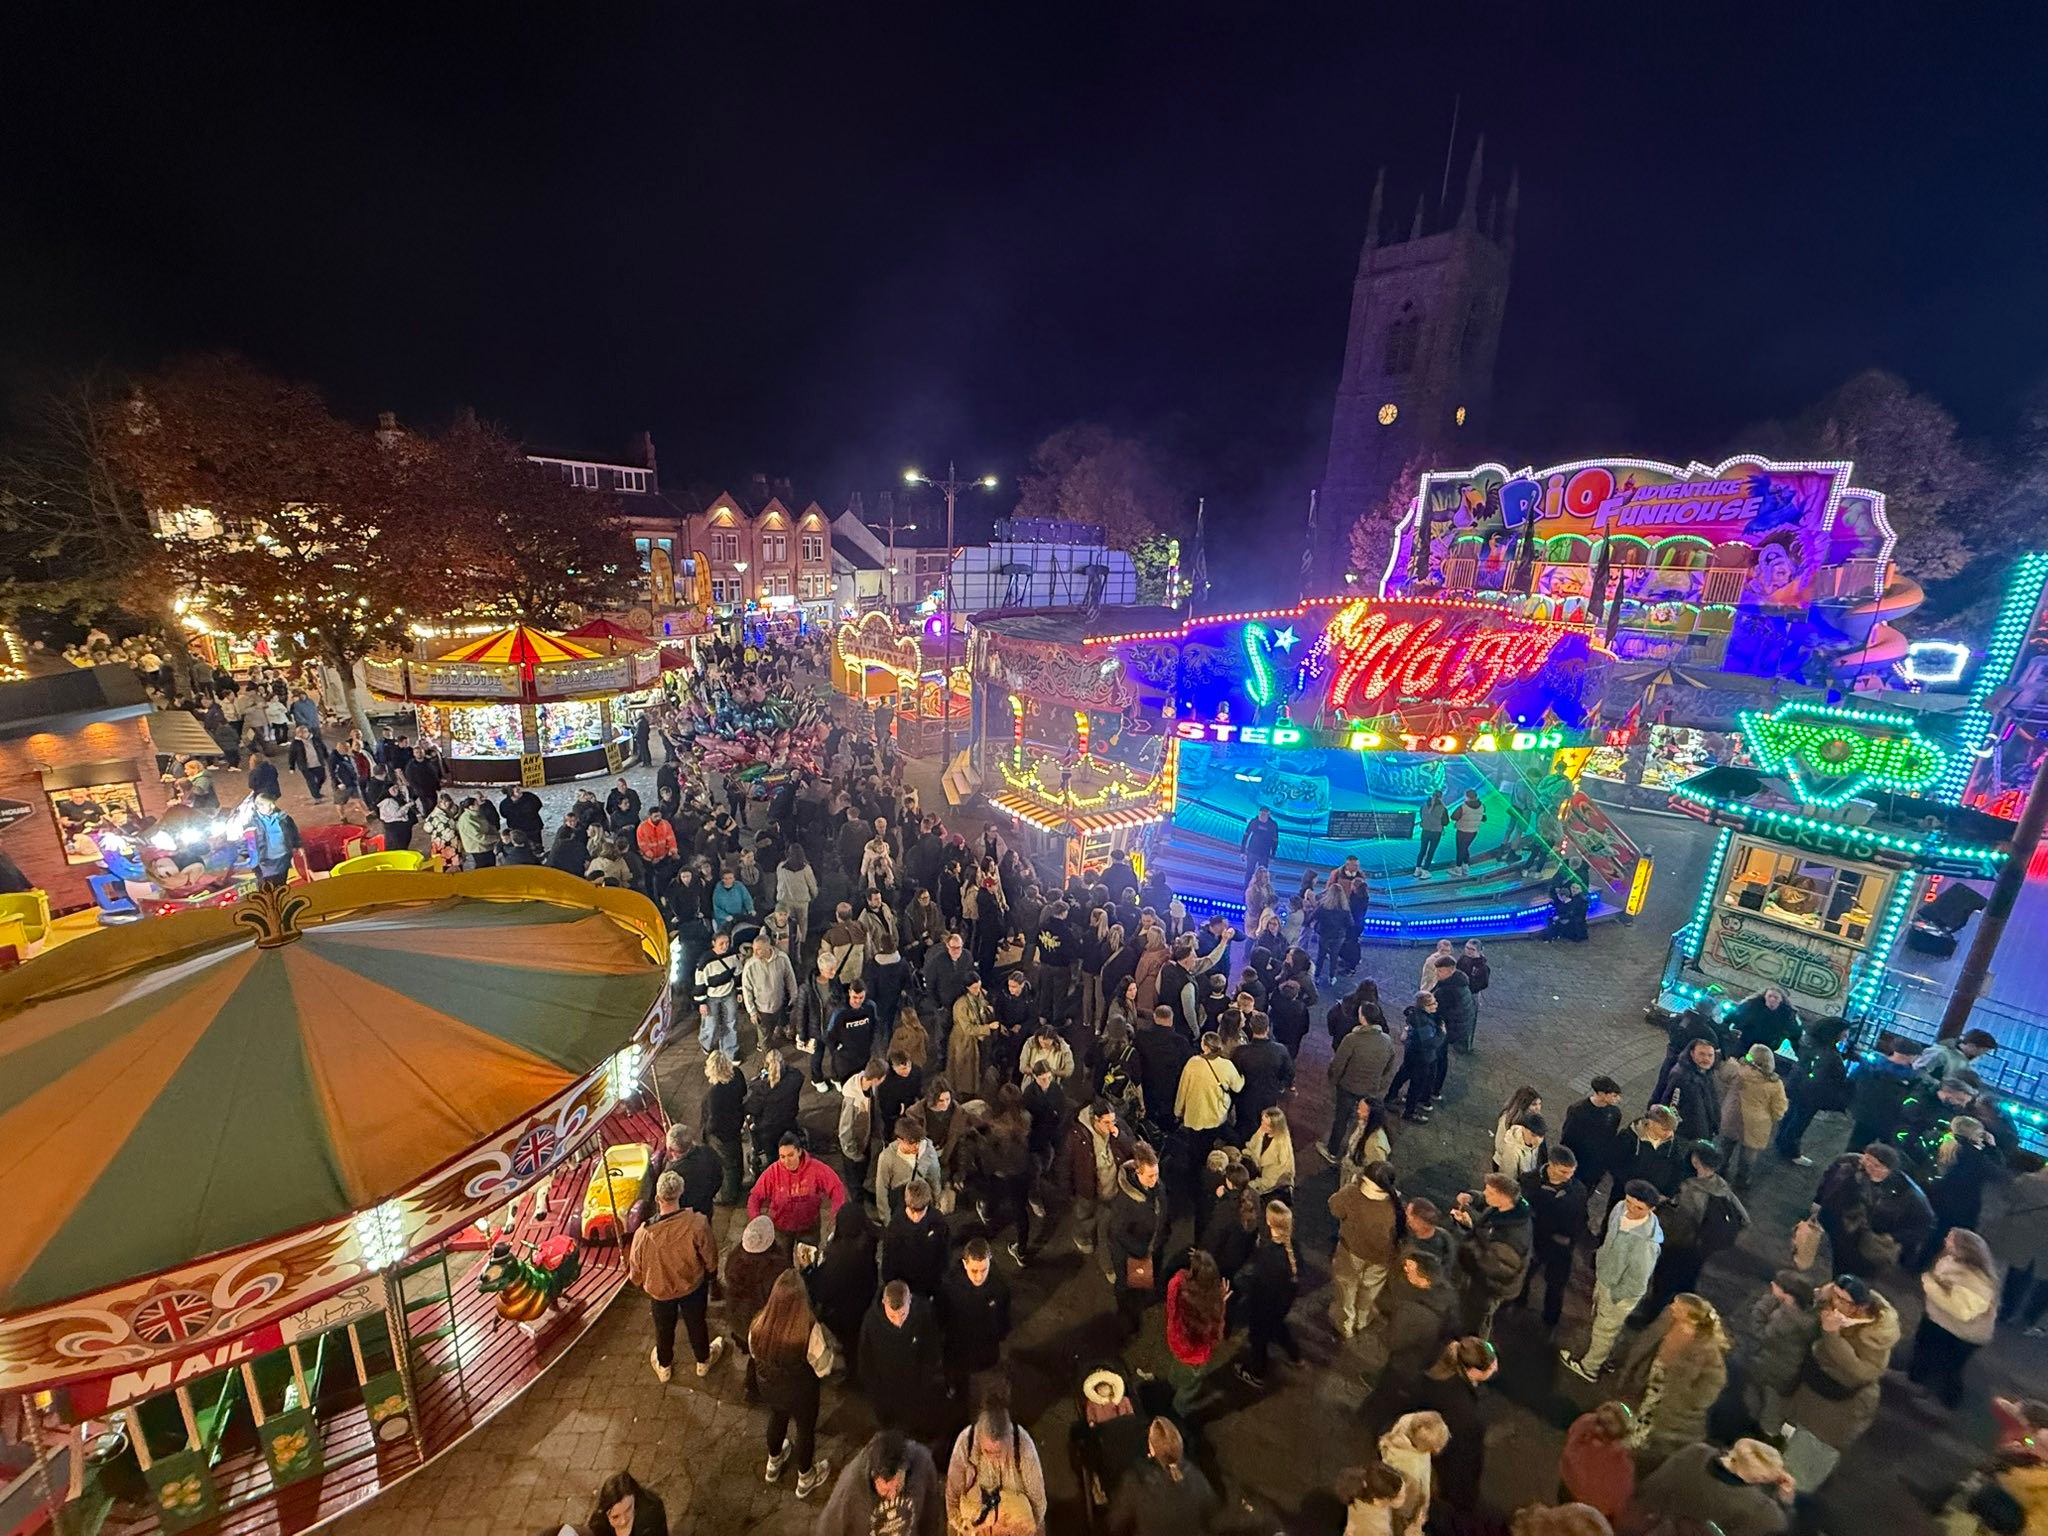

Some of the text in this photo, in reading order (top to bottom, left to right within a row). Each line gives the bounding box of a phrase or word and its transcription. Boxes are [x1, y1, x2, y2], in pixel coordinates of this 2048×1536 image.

[1634, 480, 1743, 502] ADVENTURE
[1593, 496, 1763, 530] FUNHOUSE
[1175, 720, 1302, 746] STEP
[1399, 733, 1459, 752] TO
[1470, 733, 1499, 752] A
[1749, 716, 1940, 783] VOID
[523, 755, 540, 766] ANY
[523, 763, 542, 774] PRIZE
[0, 806, 31, 817] HOUSE
[1719, 934, 1839, 997] VOID
[107, 1340, 255, 1407] MAIL
